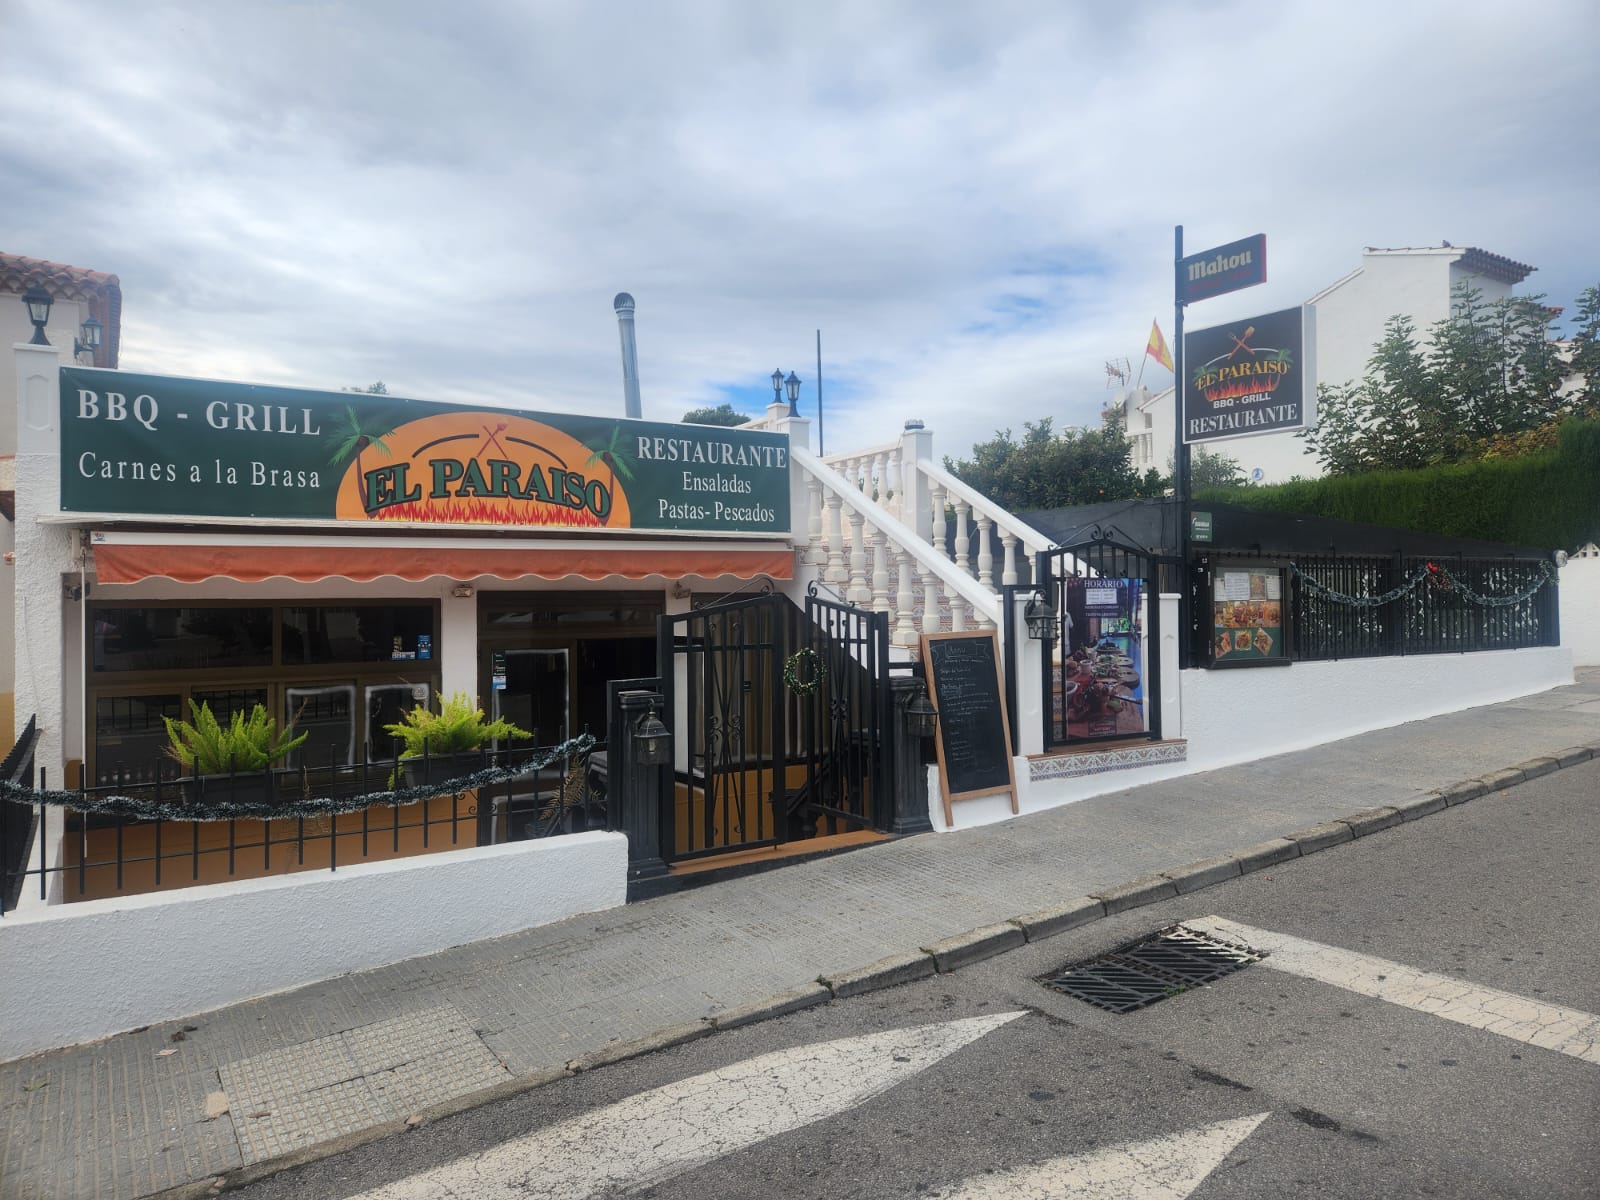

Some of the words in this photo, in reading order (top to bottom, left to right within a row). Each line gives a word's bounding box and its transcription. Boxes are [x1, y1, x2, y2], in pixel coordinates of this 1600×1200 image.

[1188, 250, 1252, 281] Mahou
[1195, 373, 1215, 391] EL
[1218, 360, 1288, 382] PARAISO
[76, 389, 159, 431] BBQ
[205, 400, 320, 436] GRILL
[1213, 398, 1234, 409] BBQ
[1241, 392, 1271, 404] GRILL
[1190, 403, 1297, 435] RESTAURANTE
[636, 436, 787, 469] RESTAURANTE
[79, 451, 177, 482] Carnes
[189, 465, 202, 483] a
[215, 459, 238, 485] la
[250, 461, 320, 488] Brasa
[682, 471, 751, 494] Ensaladas
[364, 462, 422, 513] EL
[429, 457, 611, 518] PARAISO
[714, 499, 775, 523] Pescados
[1084, 579, 1123, 588] HORARIO
